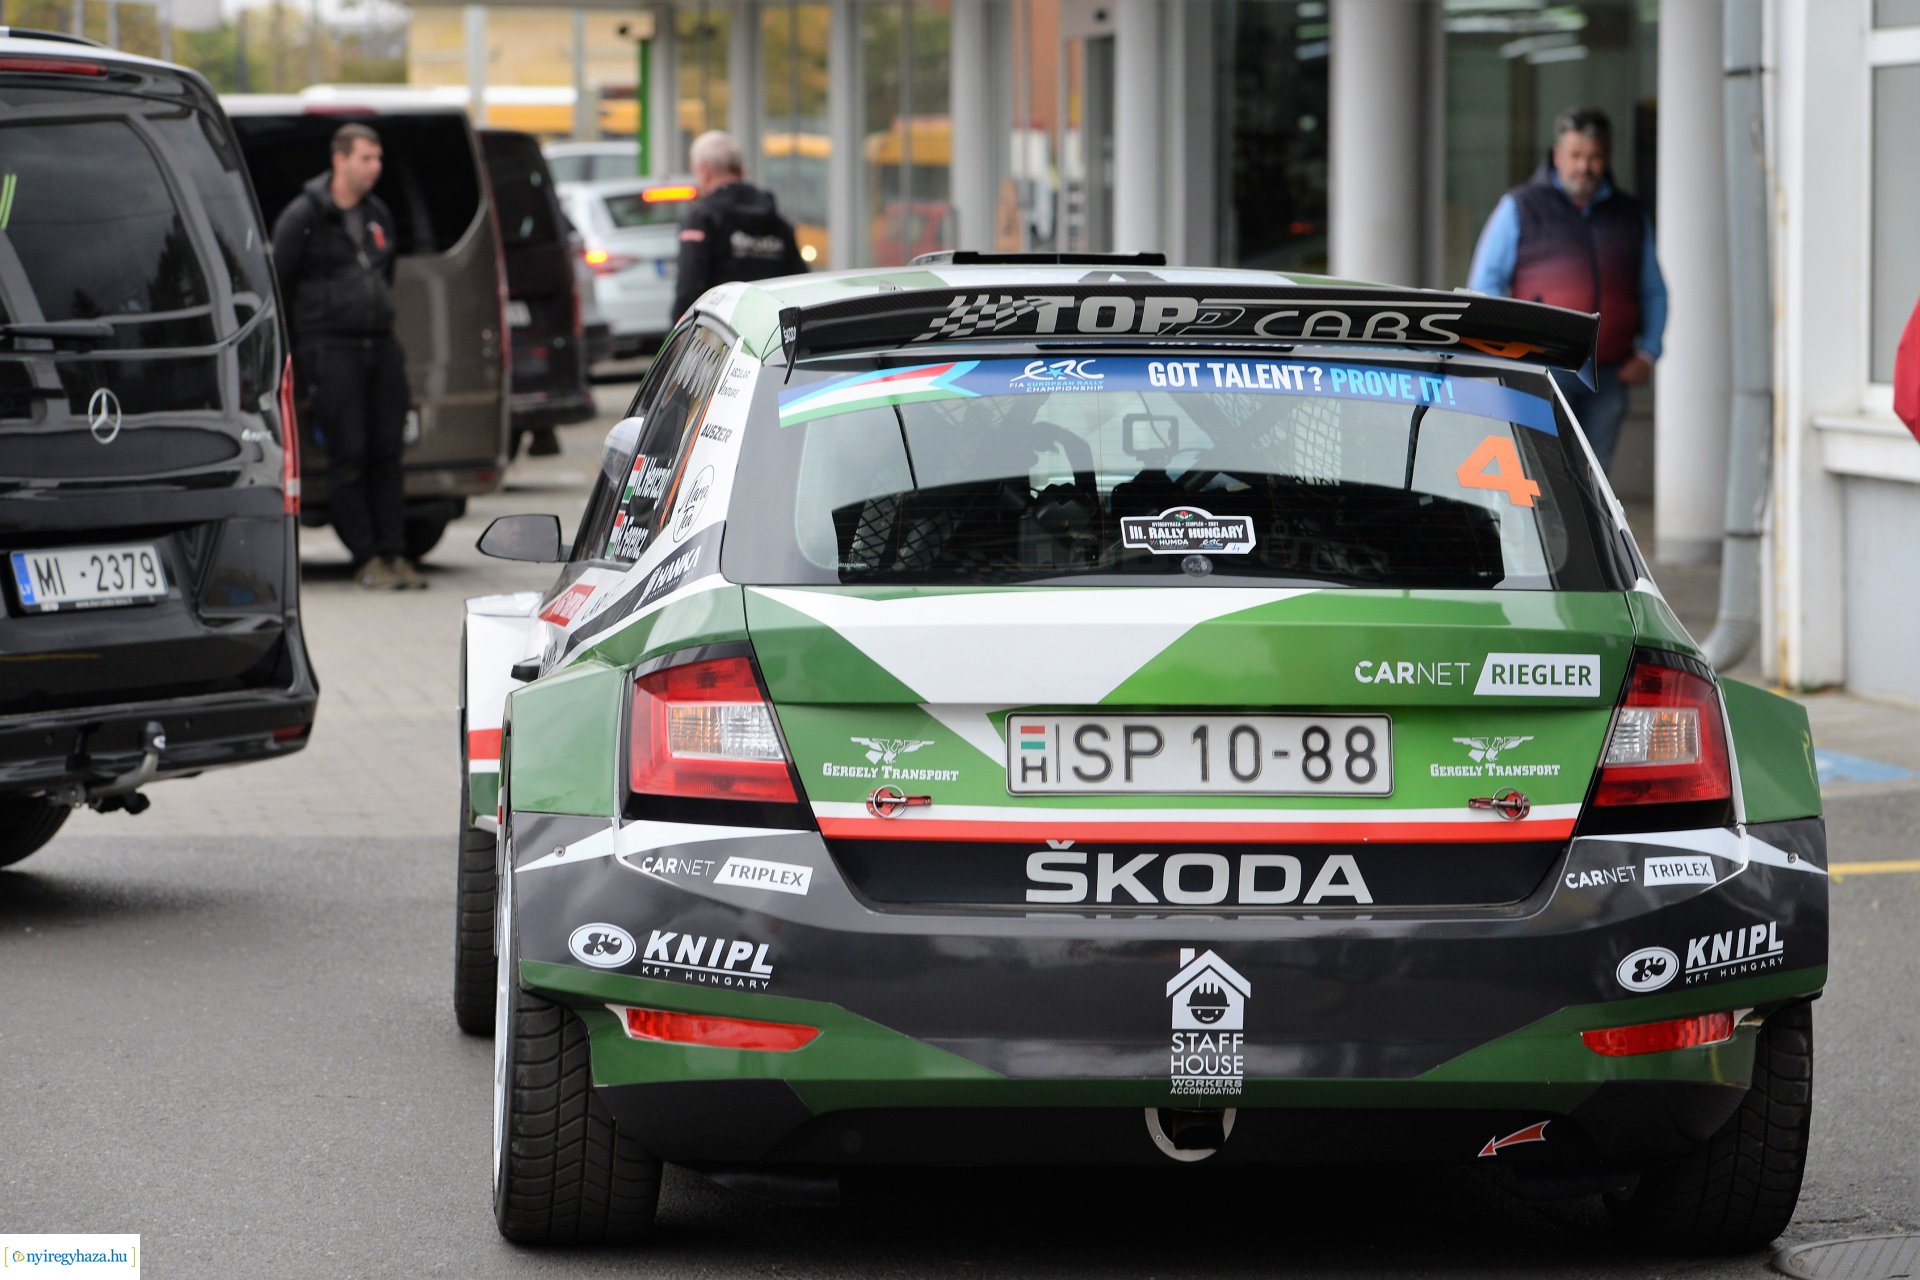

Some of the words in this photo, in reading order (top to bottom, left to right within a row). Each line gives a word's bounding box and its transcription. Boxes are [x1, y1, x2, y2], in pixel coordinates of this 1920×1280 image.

[1148, 361, 1200, 388] GOT
[1209, 363, 1323, 392] TALENT?
[1330, 367, 1417, 401] PROVE
[1419, 376, 1456, 406] IT!
[1455, 434, 1542, 509] 4
[1129, 525, 1147, 540] III.
[1149, 527, 1185, 539] RALLY
[1188, 525, 1244, 539] HUNGARY
[1355, 660, 1471, 686] CARNET
[1491, 663, 1593, 686] RIEGLER
[823, 762, 878, 779] GERGELY
[882, 765, 960, 782] TRANSPORT
[1020, 756, 1048, 784] H
[1430, 763, 1483, 777] GERGELY
[1485, 763, 1561, 777] TRANSPORT
[641, 856, 715, 877] CARNET
[729, 863, 804, 887] TRIPLEX
[1025, 839, 1374, 905] ŠKODA
[1565, 865, 1637, 889] CARNET
[1648, 862, 1711, 879] TRIPLEX
[643, 929, 774, 974] KNIPL
[1685, 920, 1784, 969] KNIPL
[642, 966, 672, 978] KFT
[685, 972, 770, 990] HUNGARY
[1685, 972, 1709, 985] KFT
[1720, 956, 1784, 977] HUNGARY
[1171, 1032, 1244, 1053] STAFF
[1170, 1055, 1244, 1075] HOUSE
[1170, 1087, 1242, 1095] ACCOMODATION
[1171, 1079, 1243, 1087] WORKERS
